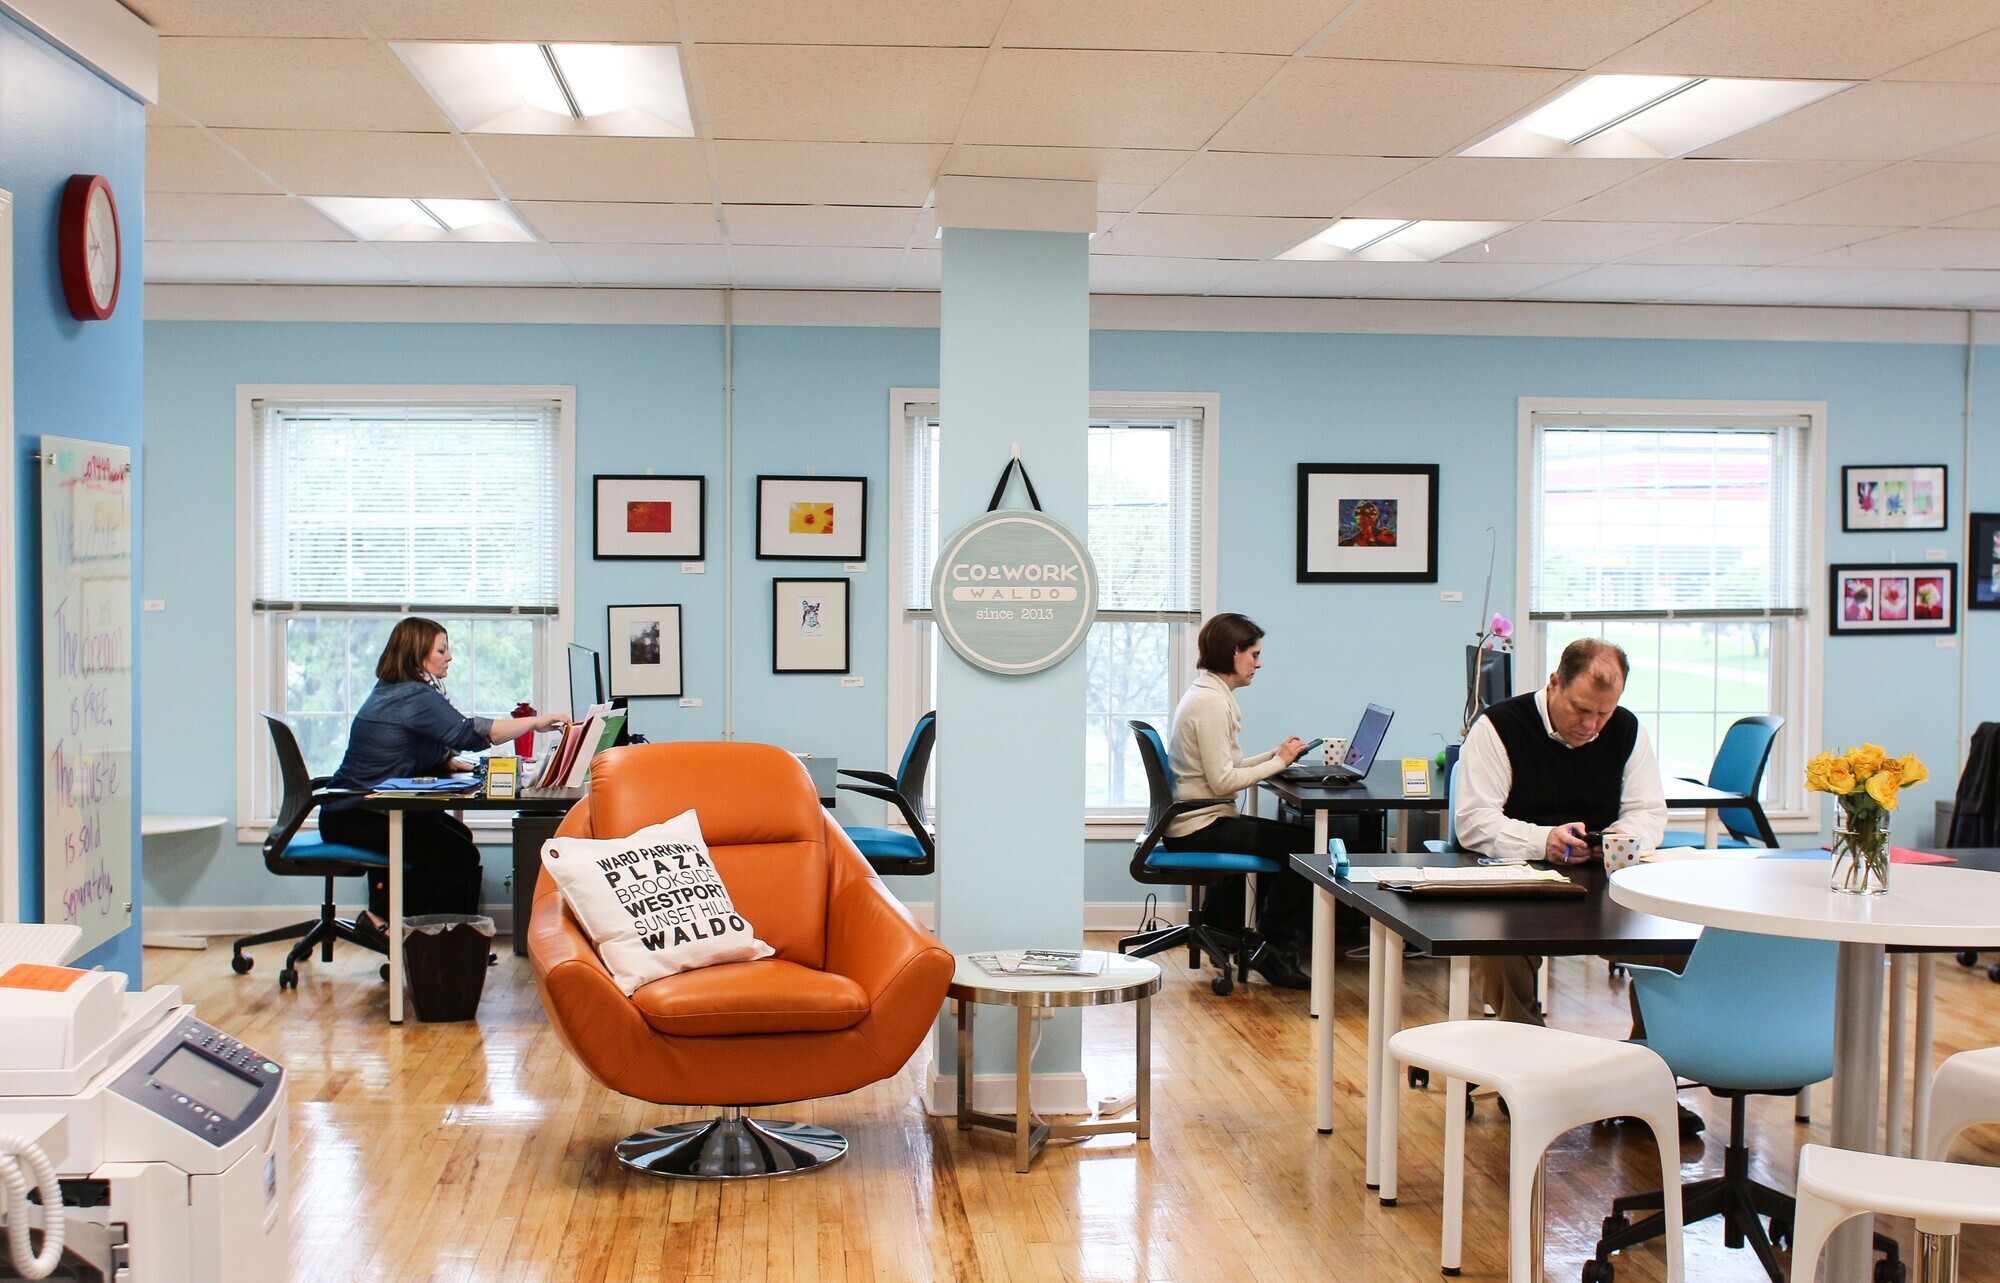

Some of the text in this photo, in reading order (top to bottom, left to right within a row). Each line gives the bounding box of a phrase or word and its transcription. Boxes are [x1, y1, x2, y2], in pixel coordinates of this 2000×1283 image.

[970, 588, 1060, 599] WALDO
[976, 607, 1054, 620] since 2013
[54, 596, 125, 680] The dream
[52, 737, 75, 816] The
[63, 811, 100, 869] is sold
[596, 850, 640, 872] WARD
[604, 852, 710, 888] PLAZA
[614, 868, 718, 905] BROOKSIDE
[624, 884, 726, 919] WESTPORT
[634, 900, 736, 936] SUNSET HILL
[640, 914, 745, 951] WALDO
